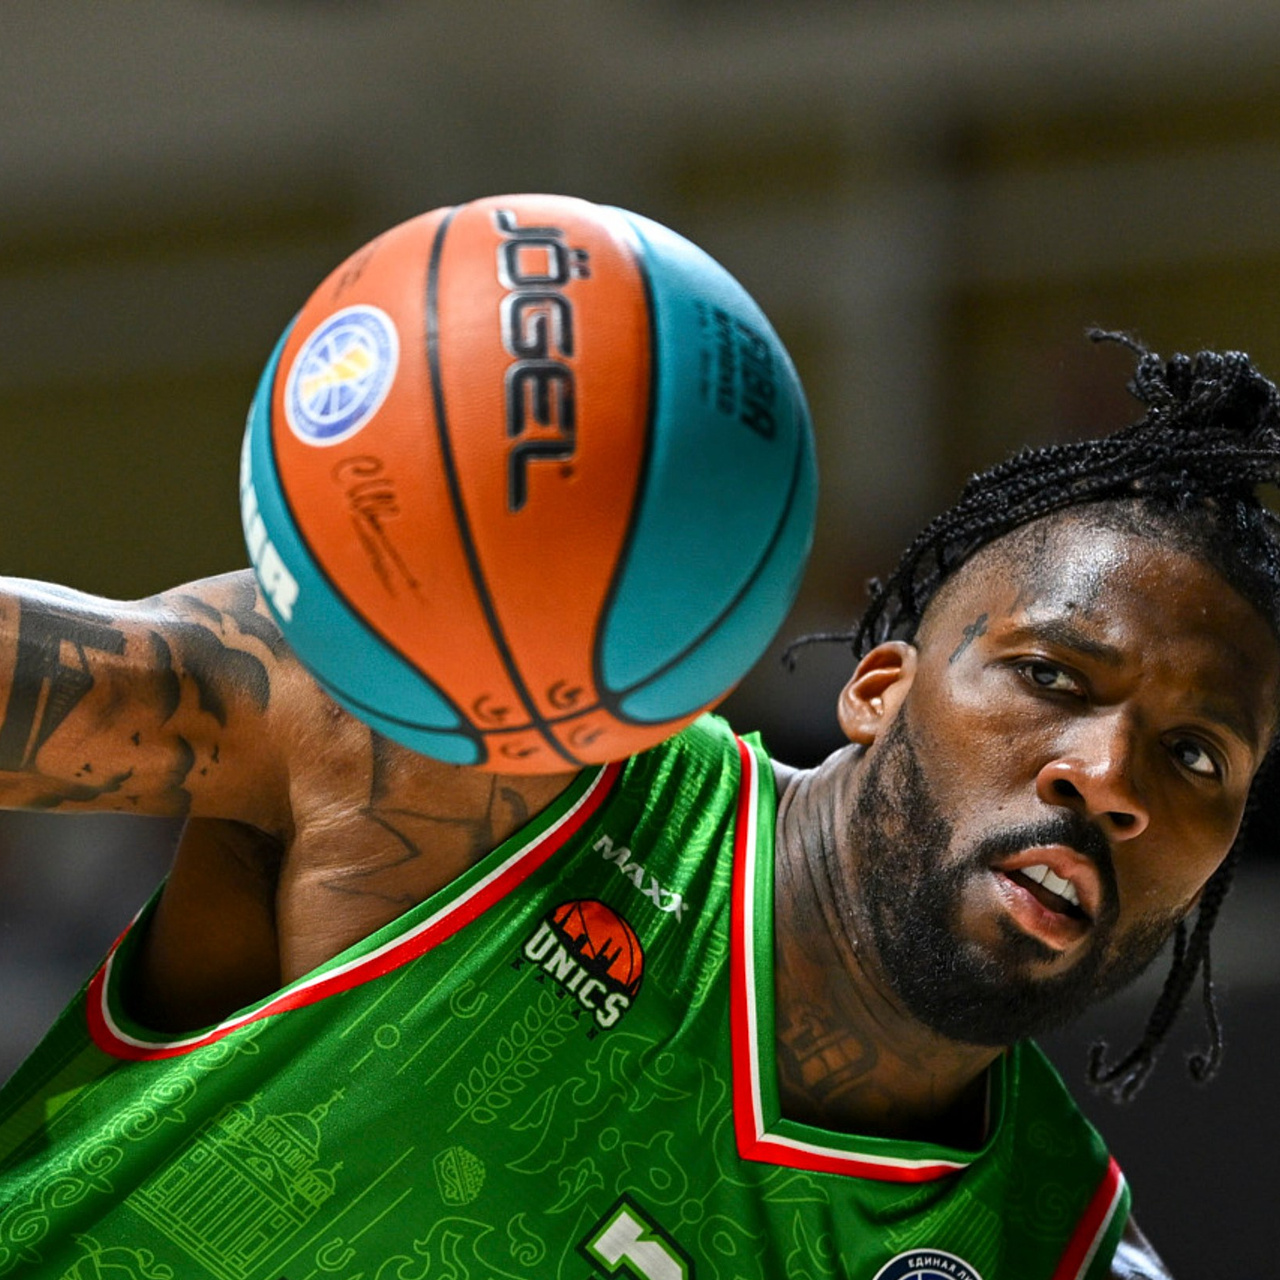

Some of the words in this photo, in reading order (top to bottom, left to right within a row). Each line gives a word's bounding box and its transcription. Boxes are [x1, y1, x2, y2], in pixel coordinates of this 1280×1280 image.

[490, 206, 591, 514] JÖGEL
[522, 919, 630, 1030] UNICS
[907, 1256, 957, 1273] ЕДИНАЯ
